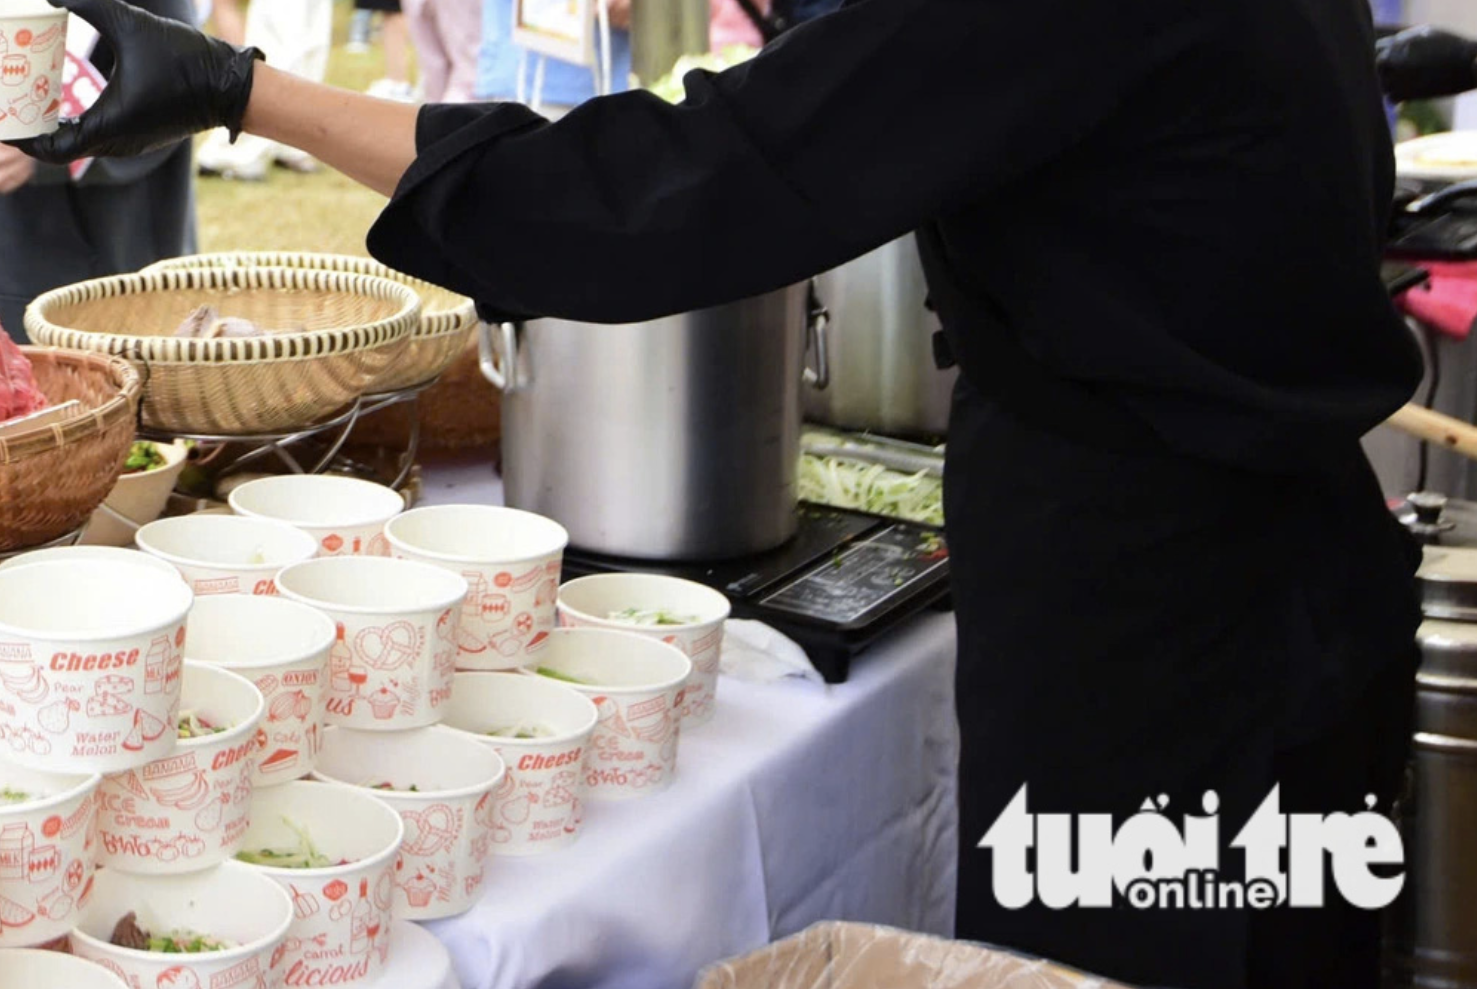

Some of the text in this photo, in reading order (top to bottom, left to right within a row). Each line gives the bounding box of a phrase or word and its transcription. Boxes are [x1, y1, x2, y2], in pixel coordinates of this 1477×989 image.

[50, 648, 140, 672] Cheese
[76, 730, 122, 743] Water
[72, 743, 117, 757] Melon
